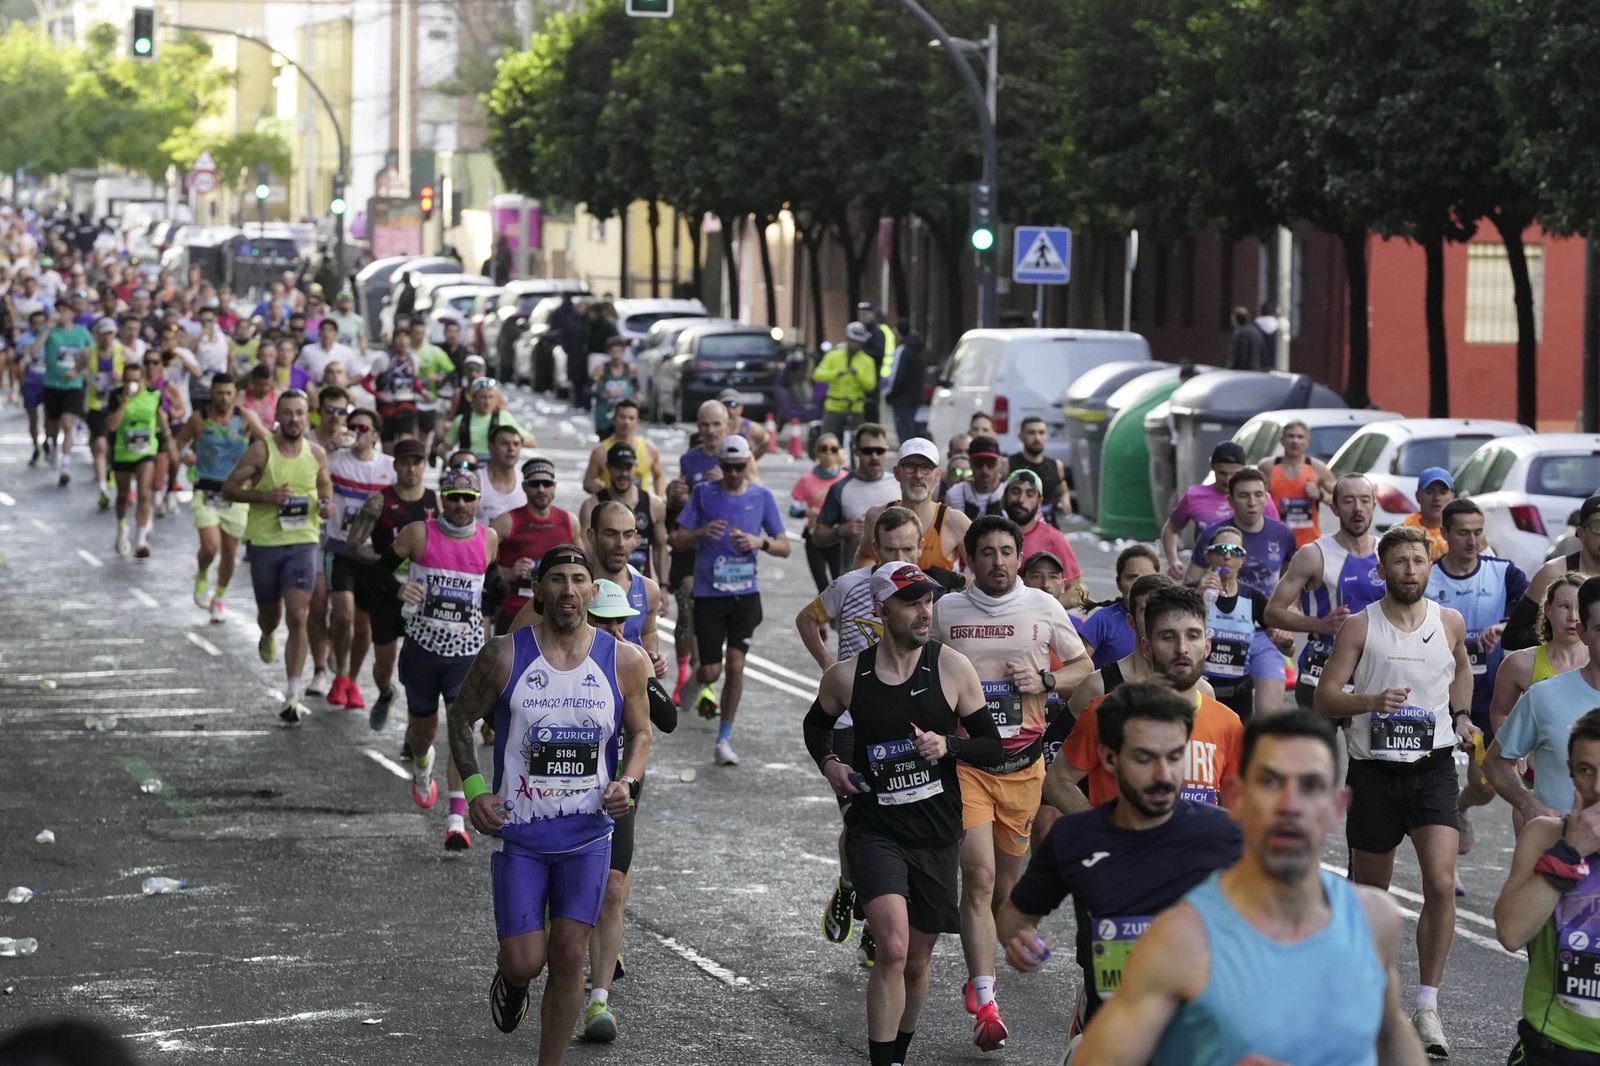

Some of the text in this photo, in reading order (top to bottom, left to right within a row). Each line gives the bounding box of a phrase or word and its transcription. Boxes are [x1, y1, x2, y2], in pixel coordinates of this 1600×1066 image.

[426, 575, 472, 589] ENTRENA
[433, 608, 461, 621] PABLO
[1217, 631, 1246, 640] ZURICH
[1210, 652, 1234, 664] SUSY
[562, 698, 606, 709] ATLETISMO
[1394, 708, 1429, 718] ZURICH
[556, 731, 594, 740] ZURICH
[1394, 725, 1414, 734] 4710
[1386, 736, 1421, 749] LINAS
[556, 749, 577, 758] 5184
[547, 761, 584, 775] FABIO
[894, 761, 916, 773] 3798
[886, 769, 930, 791] JULIEN
